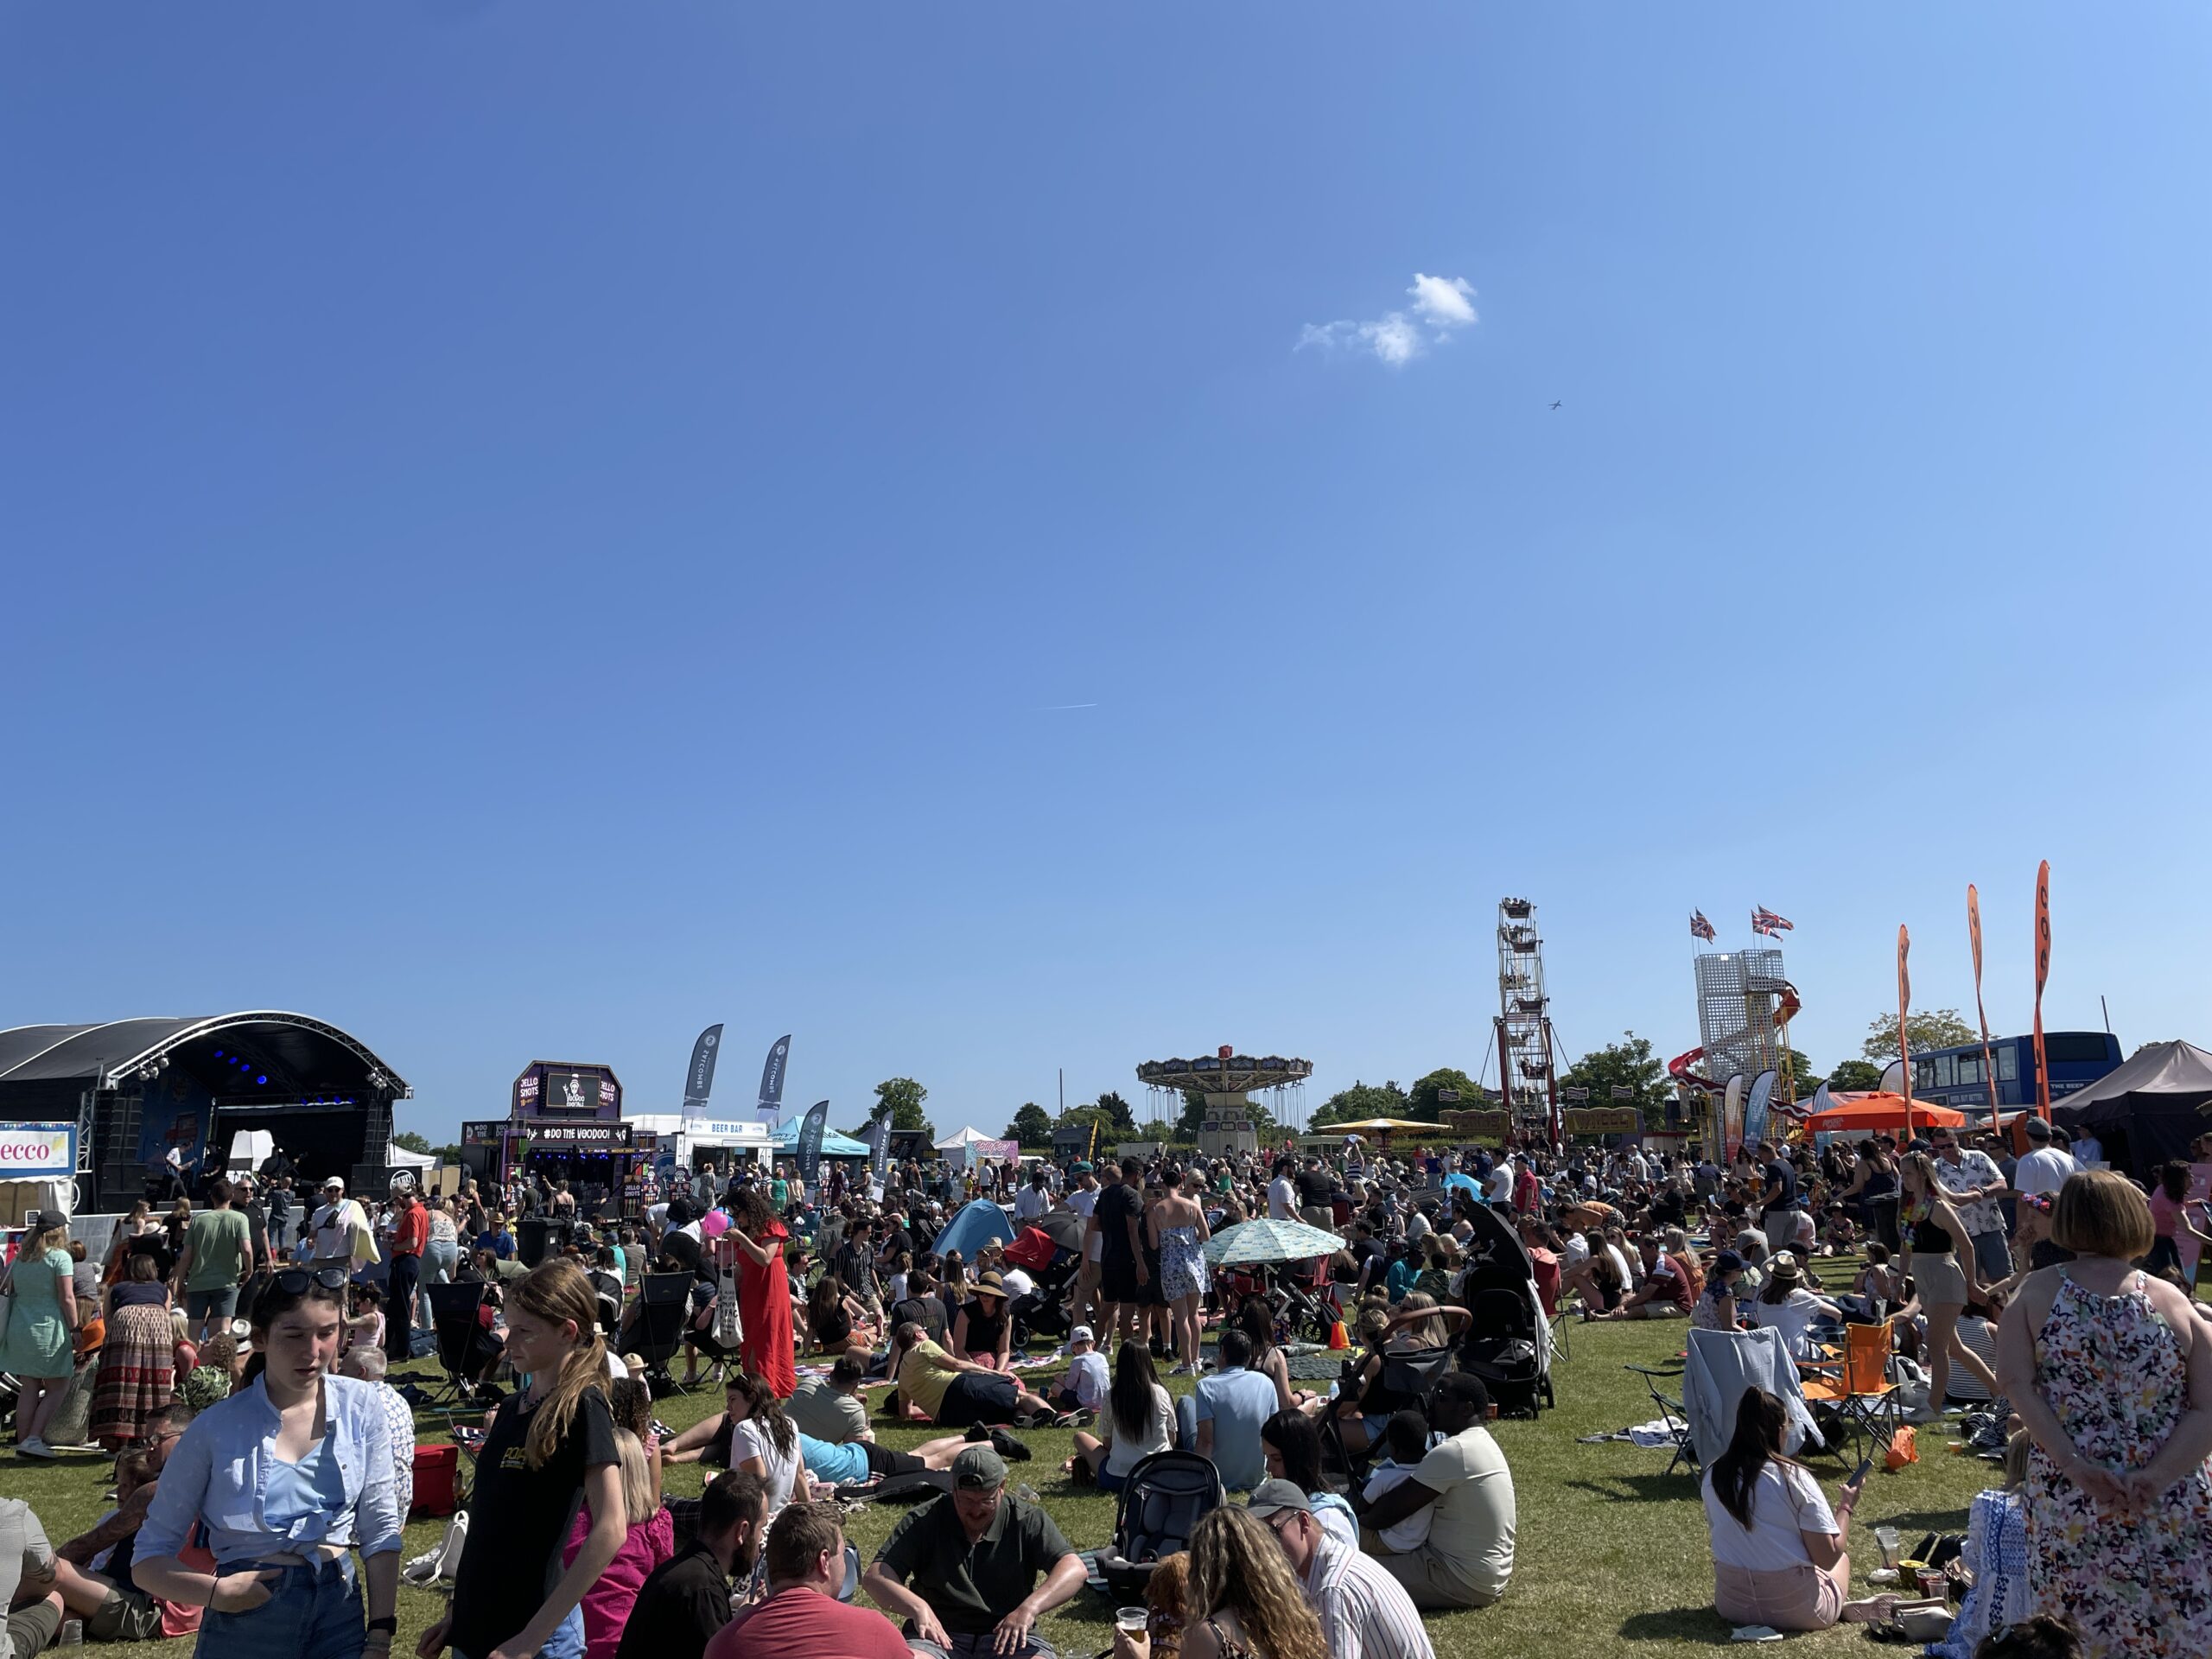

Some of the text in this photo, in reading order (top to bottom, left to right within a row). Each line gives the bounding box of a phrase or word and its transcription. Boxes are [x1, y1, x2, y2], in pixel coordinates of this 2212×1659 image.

[520, 1077, 538, 1088] JELLO
[520, 1087, 539, 1097] SHOTS
[711, 1123, 728, 1133] BEER
[730, 1124, 743, 1133] BAR
[543, 1128, 610, 1140] #DO THE VOODOO!
